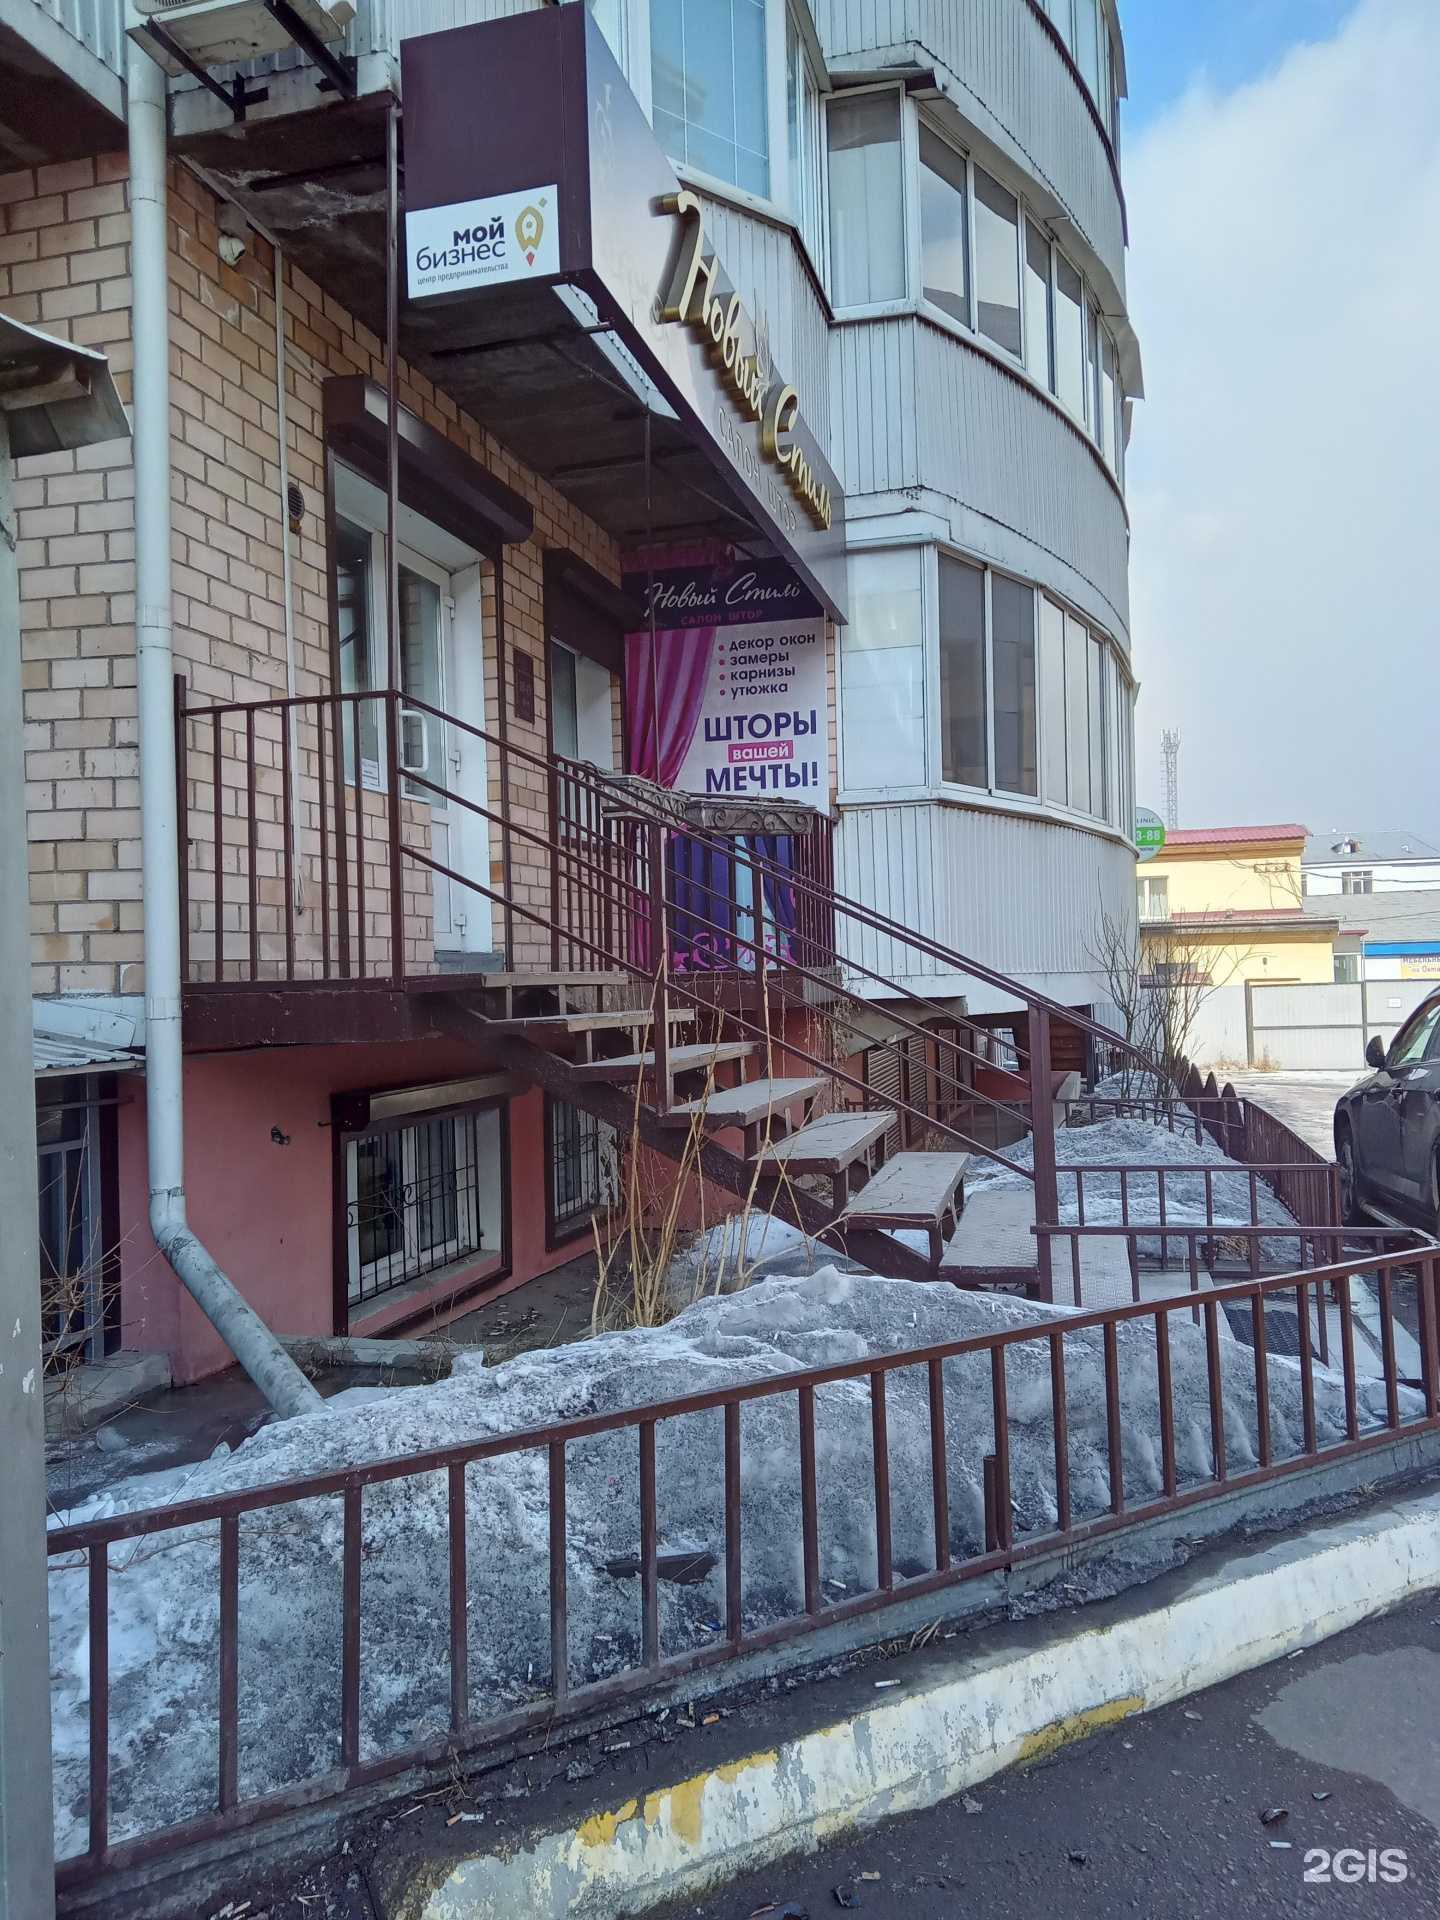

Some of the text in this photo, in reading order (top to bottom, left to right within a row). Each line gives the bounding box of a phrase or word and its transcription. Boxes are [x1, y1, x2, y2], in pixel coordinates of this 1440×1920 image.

[453, 216, 505, 247] мой
[416, 241, 506, 271] бизнес
[418, 263, 509, 286] центр предпринимательства
[650, 189, 832, 531] Новый Стиль
[643, 572, 801, 618] Новый Стиль
[681, 609, 763, 626] САЛОН ШТОР
[729, 633, 816, 652] декор окон
[729, 652, 790, 666] замеры
[730, 666, 796, 681] карнизы
[731, 683, 789, 700] утюжка
[704, 709, 817, 742] ШТОРЫ
[732, 742, 789, 760] вашей
[705, 761, 818, 793] МЕЧТЫ!
